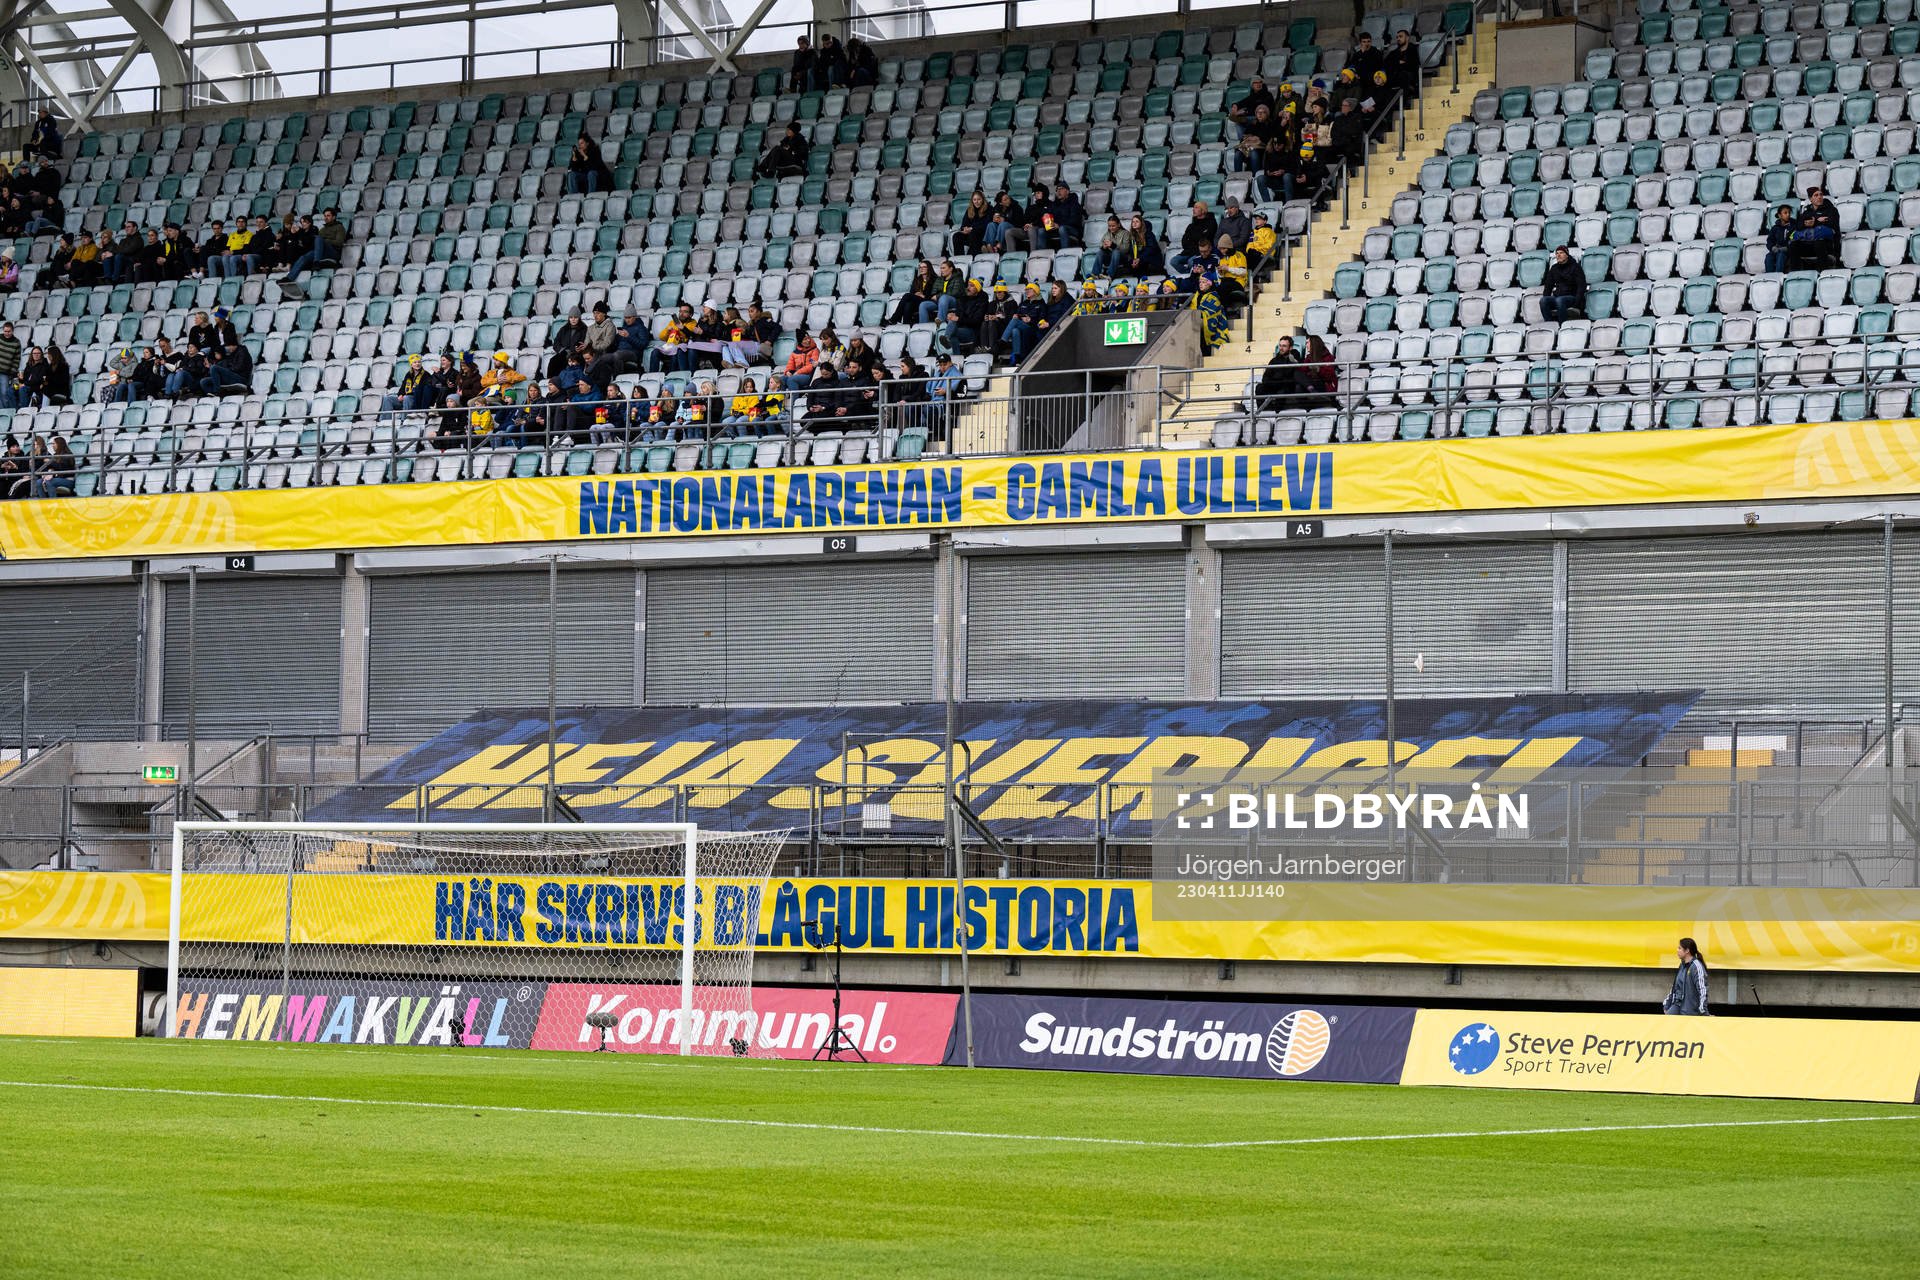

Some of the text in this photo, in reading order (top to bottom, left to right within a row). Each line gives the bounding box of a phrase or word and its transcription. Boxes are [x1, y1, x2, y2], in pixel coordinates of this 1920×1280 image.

[1468, 66, 1479, 75] 12
[1441, 99, 1451, 108] 11
[1414, 133, 1425, 141] 10
[1388, 167, 1395, 175] 9
[1332, 236, 1338, 245] 7
[1303, 271, 1310, 280] 6
[1275, 308, 1281, 317] 5
[1245, 345, 1252, 354] 4
[1214, 383, 1221, 392] 3
[979, 430, 986, 439] 2
[579, 465, 963, 536] NATIONALARENAN
[1006, 457, 1168, 523] GAMLA
[1177, 452, 1334, 516] ULLEVI
[1296, 524, 1312, 535] A5
[384, 737, 802, 810] HEJA
[435, 877, 1140, 953] HÄR SKRIVS BLÅGUL HISTORIA
[174, 985, 510, 1047] HEMMAKVÄLL
[1019, 1011, 1264, 1063] Sundström
[1505, 1032, 1705, 1063] Steve Perryman
[1504, 1057, 1612, 1076] Sport Travel
